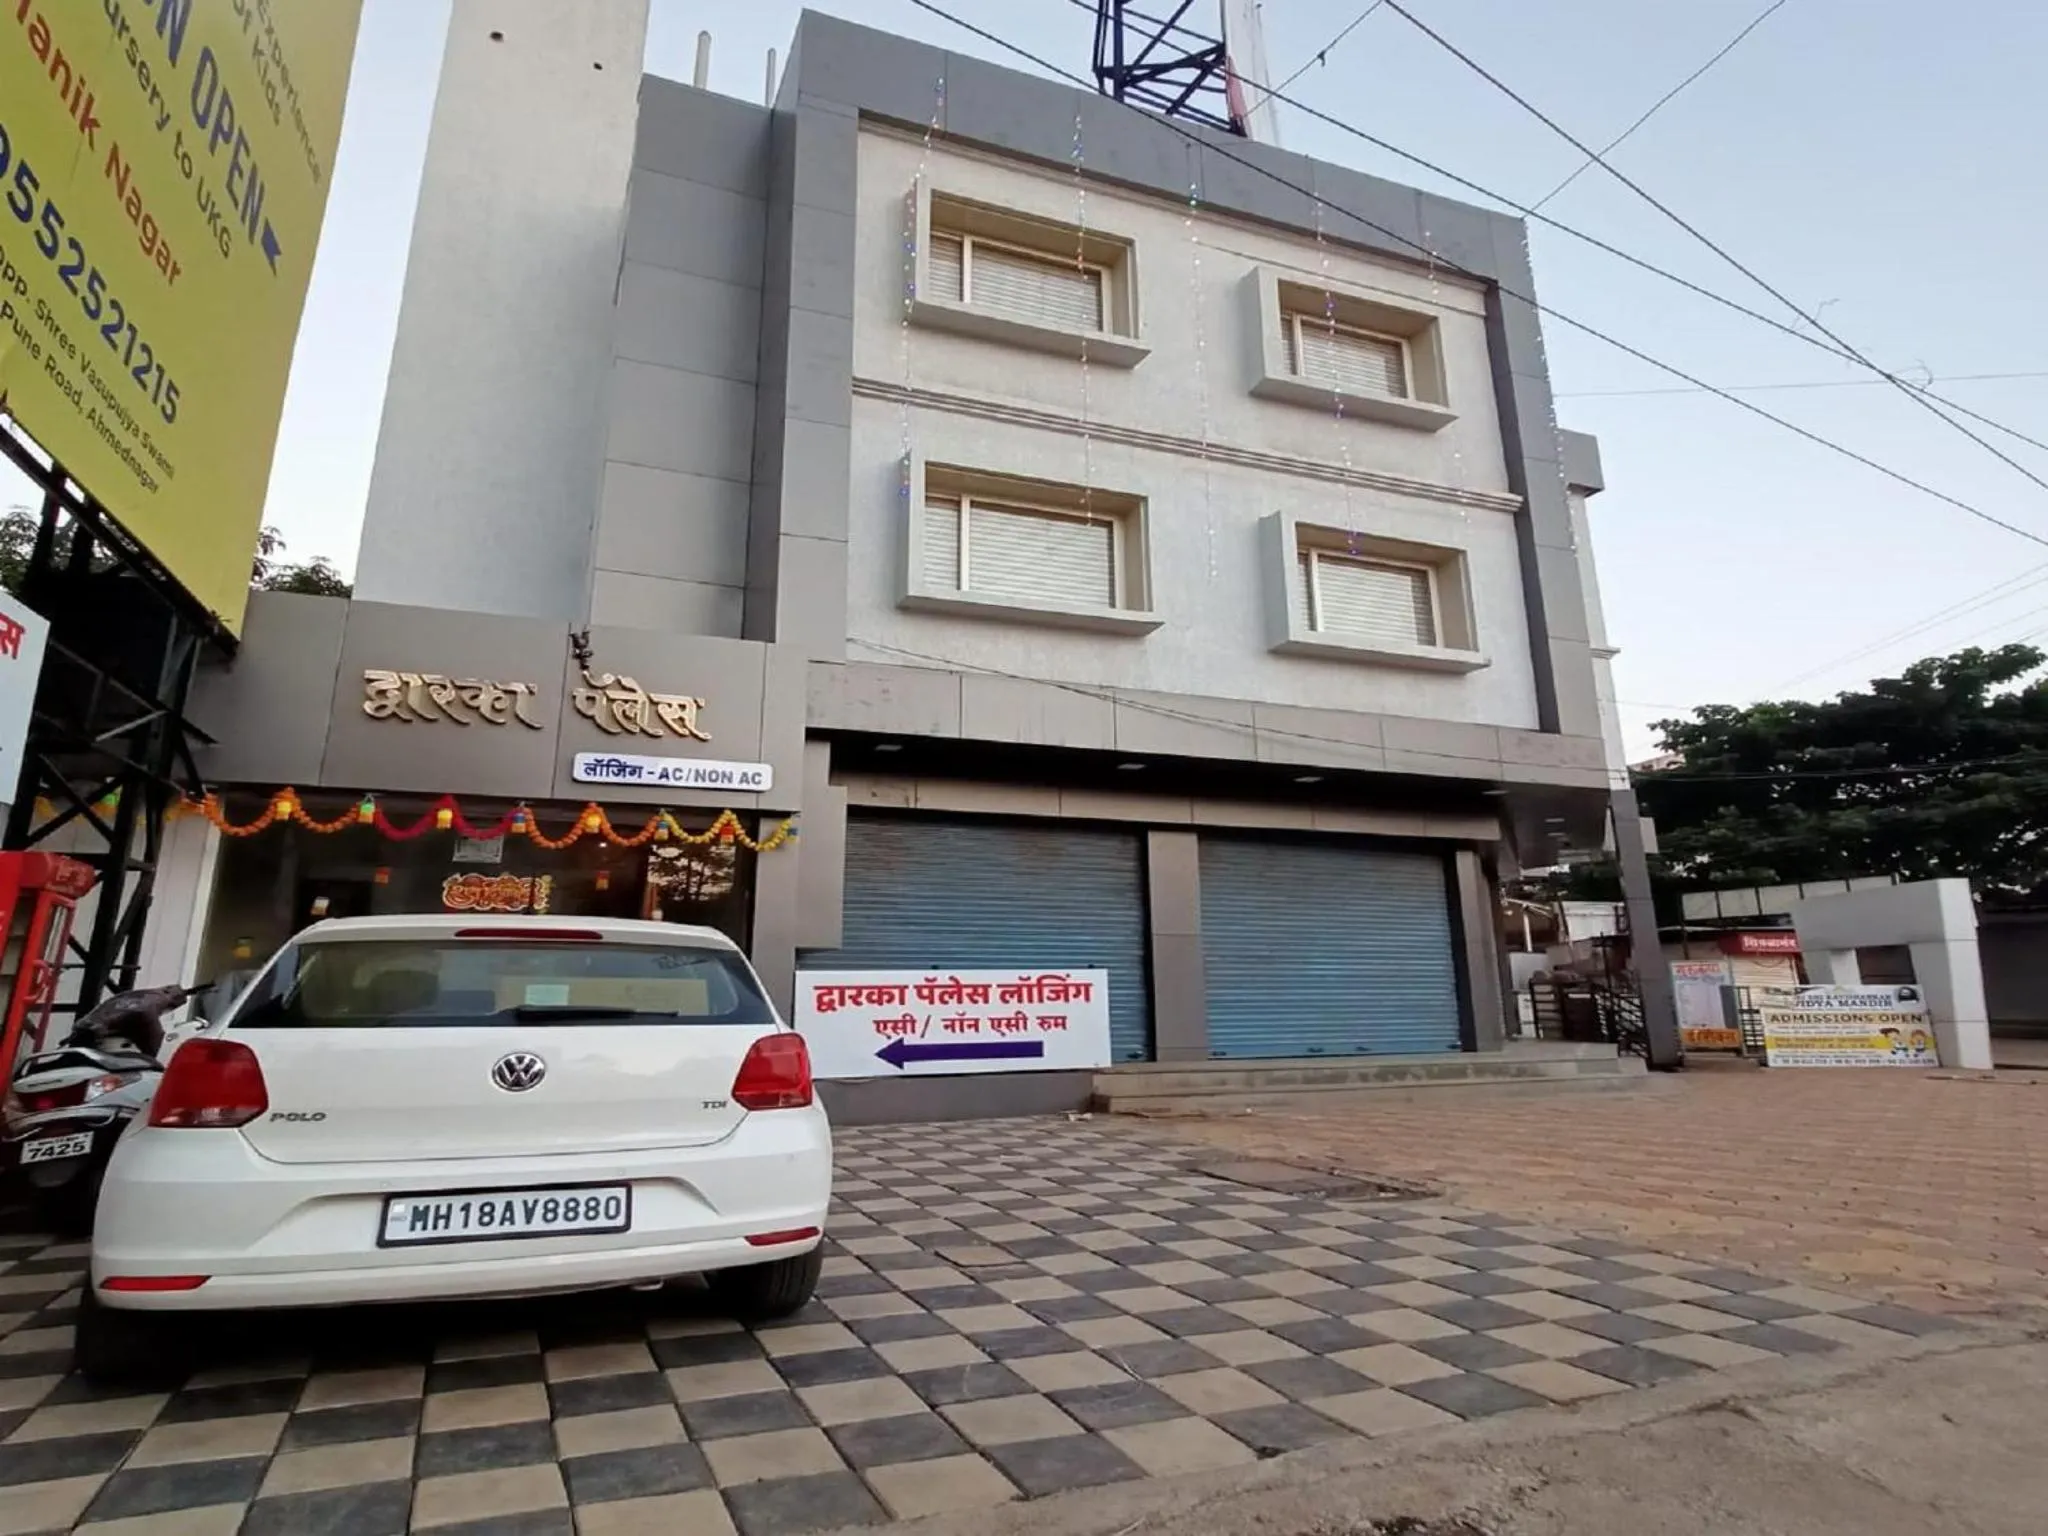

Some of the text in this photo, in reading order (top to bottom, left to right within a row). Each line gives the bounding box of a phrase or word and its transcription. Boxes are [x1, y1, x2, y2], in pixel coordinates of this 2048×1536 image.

[252, 33, 280, 127] Kids
[143, 0, 265, 245] N OPEN
[16, 0, 182, 286] anik Nagar
[174, 130, 193, 180] to
[197, 176, 231, 259] UKG
[0, 299, 160, 494] Pune Road, Ahmednagar
[34, 298, 77, 361] Shree
[80, 351, 140, 437] Vasupujya
[140, 431, 175, 481] Swami
[583, 758, 643, 779] लॉजिंग
[738, 771, 762, 785] AC
[813, 974, 1093, 1013] द्वारका पॅलेस लॉजिंग
[942, 1012, 980, 1034] नॉन
[988, 1011, 1028, 1037] एसी
[1770, 1013, 1923, 1023] ADMISSIONS OPEN
[269, 1111, 327, 1122] POLO
[28, 1141, 86, 1159] 7425
[409, 1195, 622, 1232] MH18AV8880
